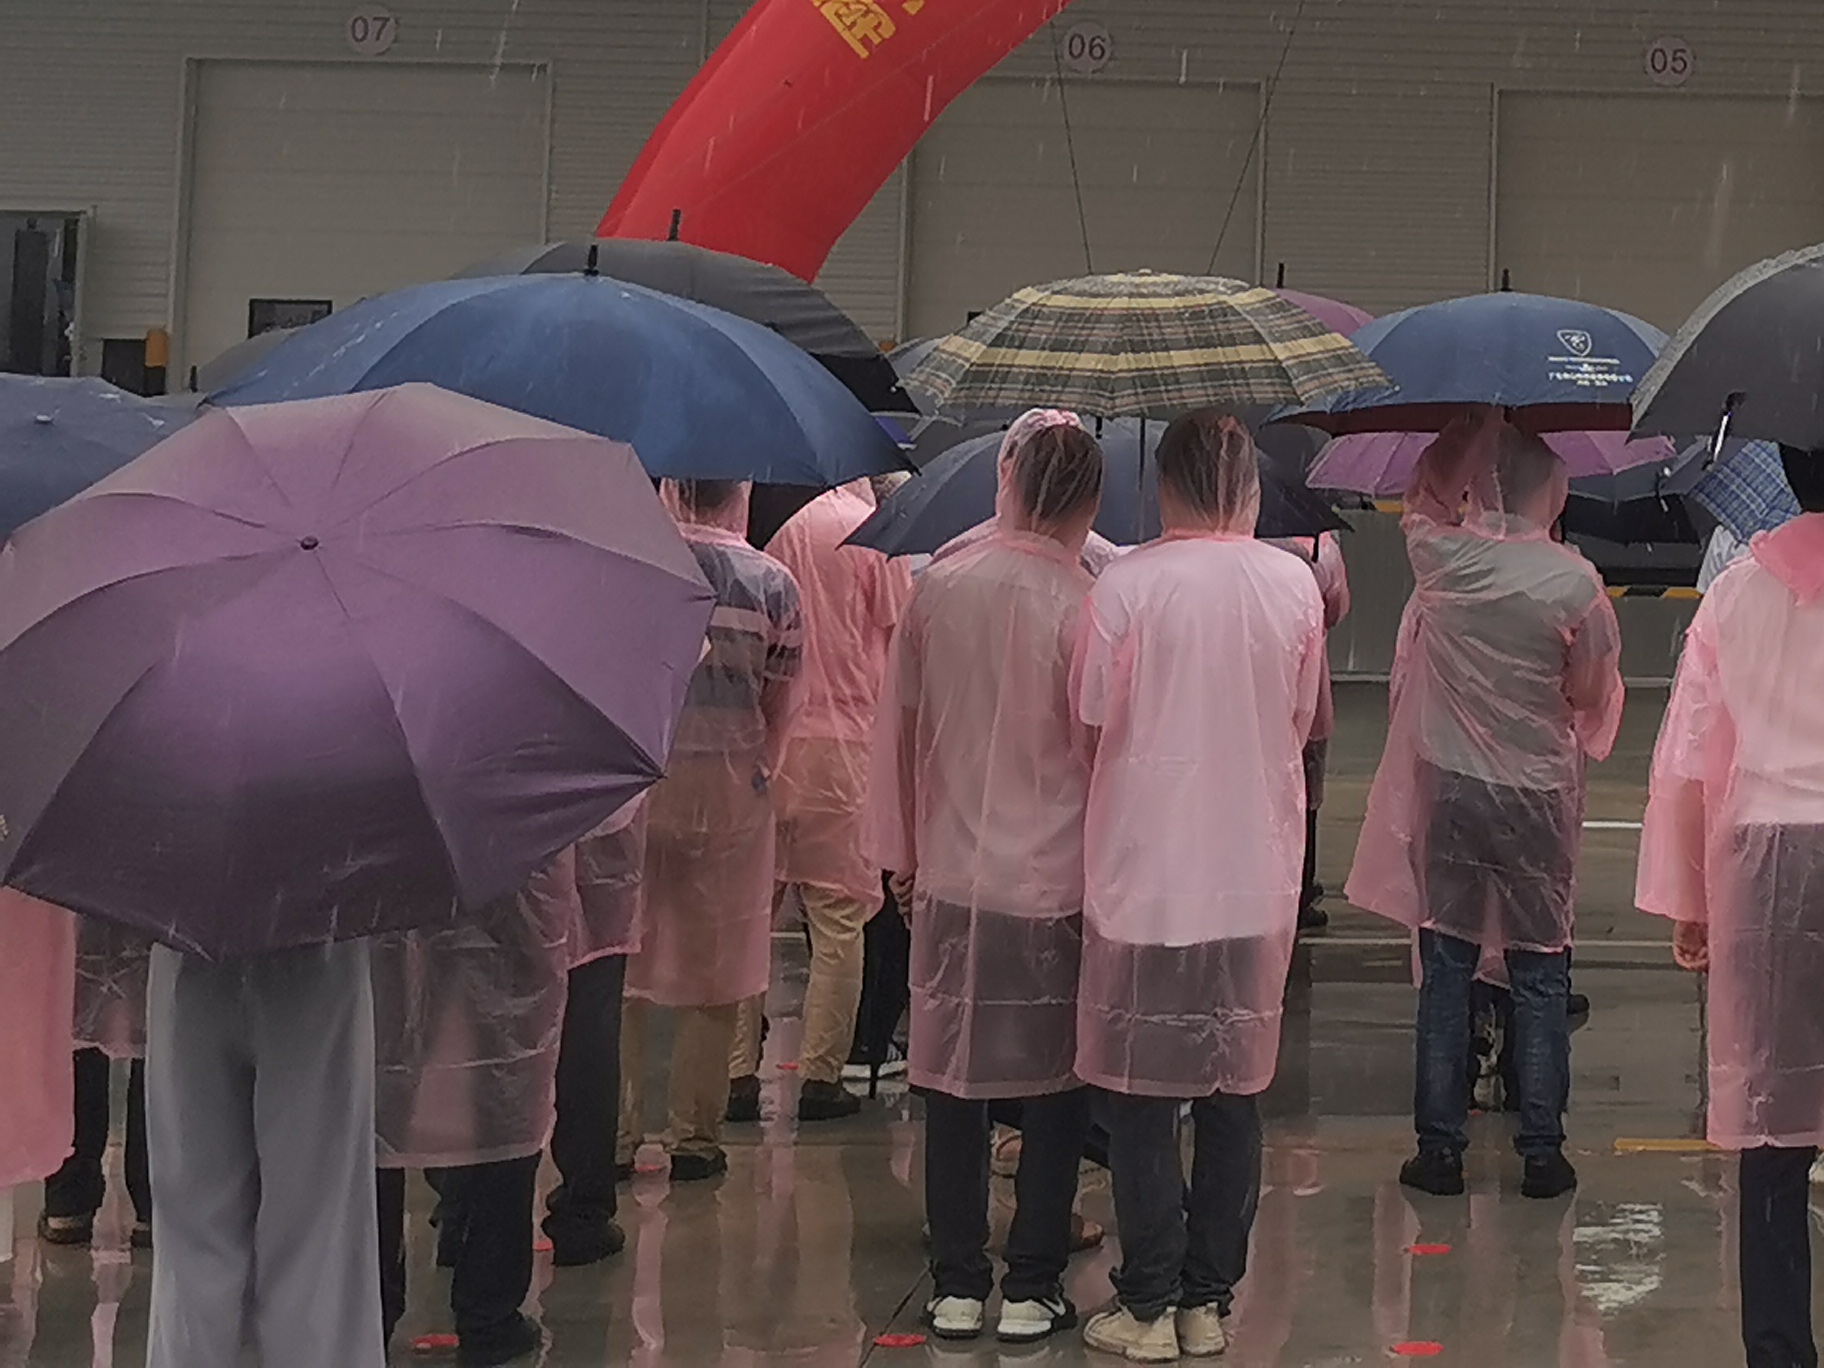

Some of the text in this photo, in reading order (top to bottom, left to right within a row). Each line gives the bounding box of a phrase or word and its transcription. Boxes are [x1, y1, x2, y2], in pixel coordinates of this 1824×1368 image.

[350, 15, 391, 43] 07
[1068, 33, 1106, 61] 06
[1650, 47, 1688, 74] 05
